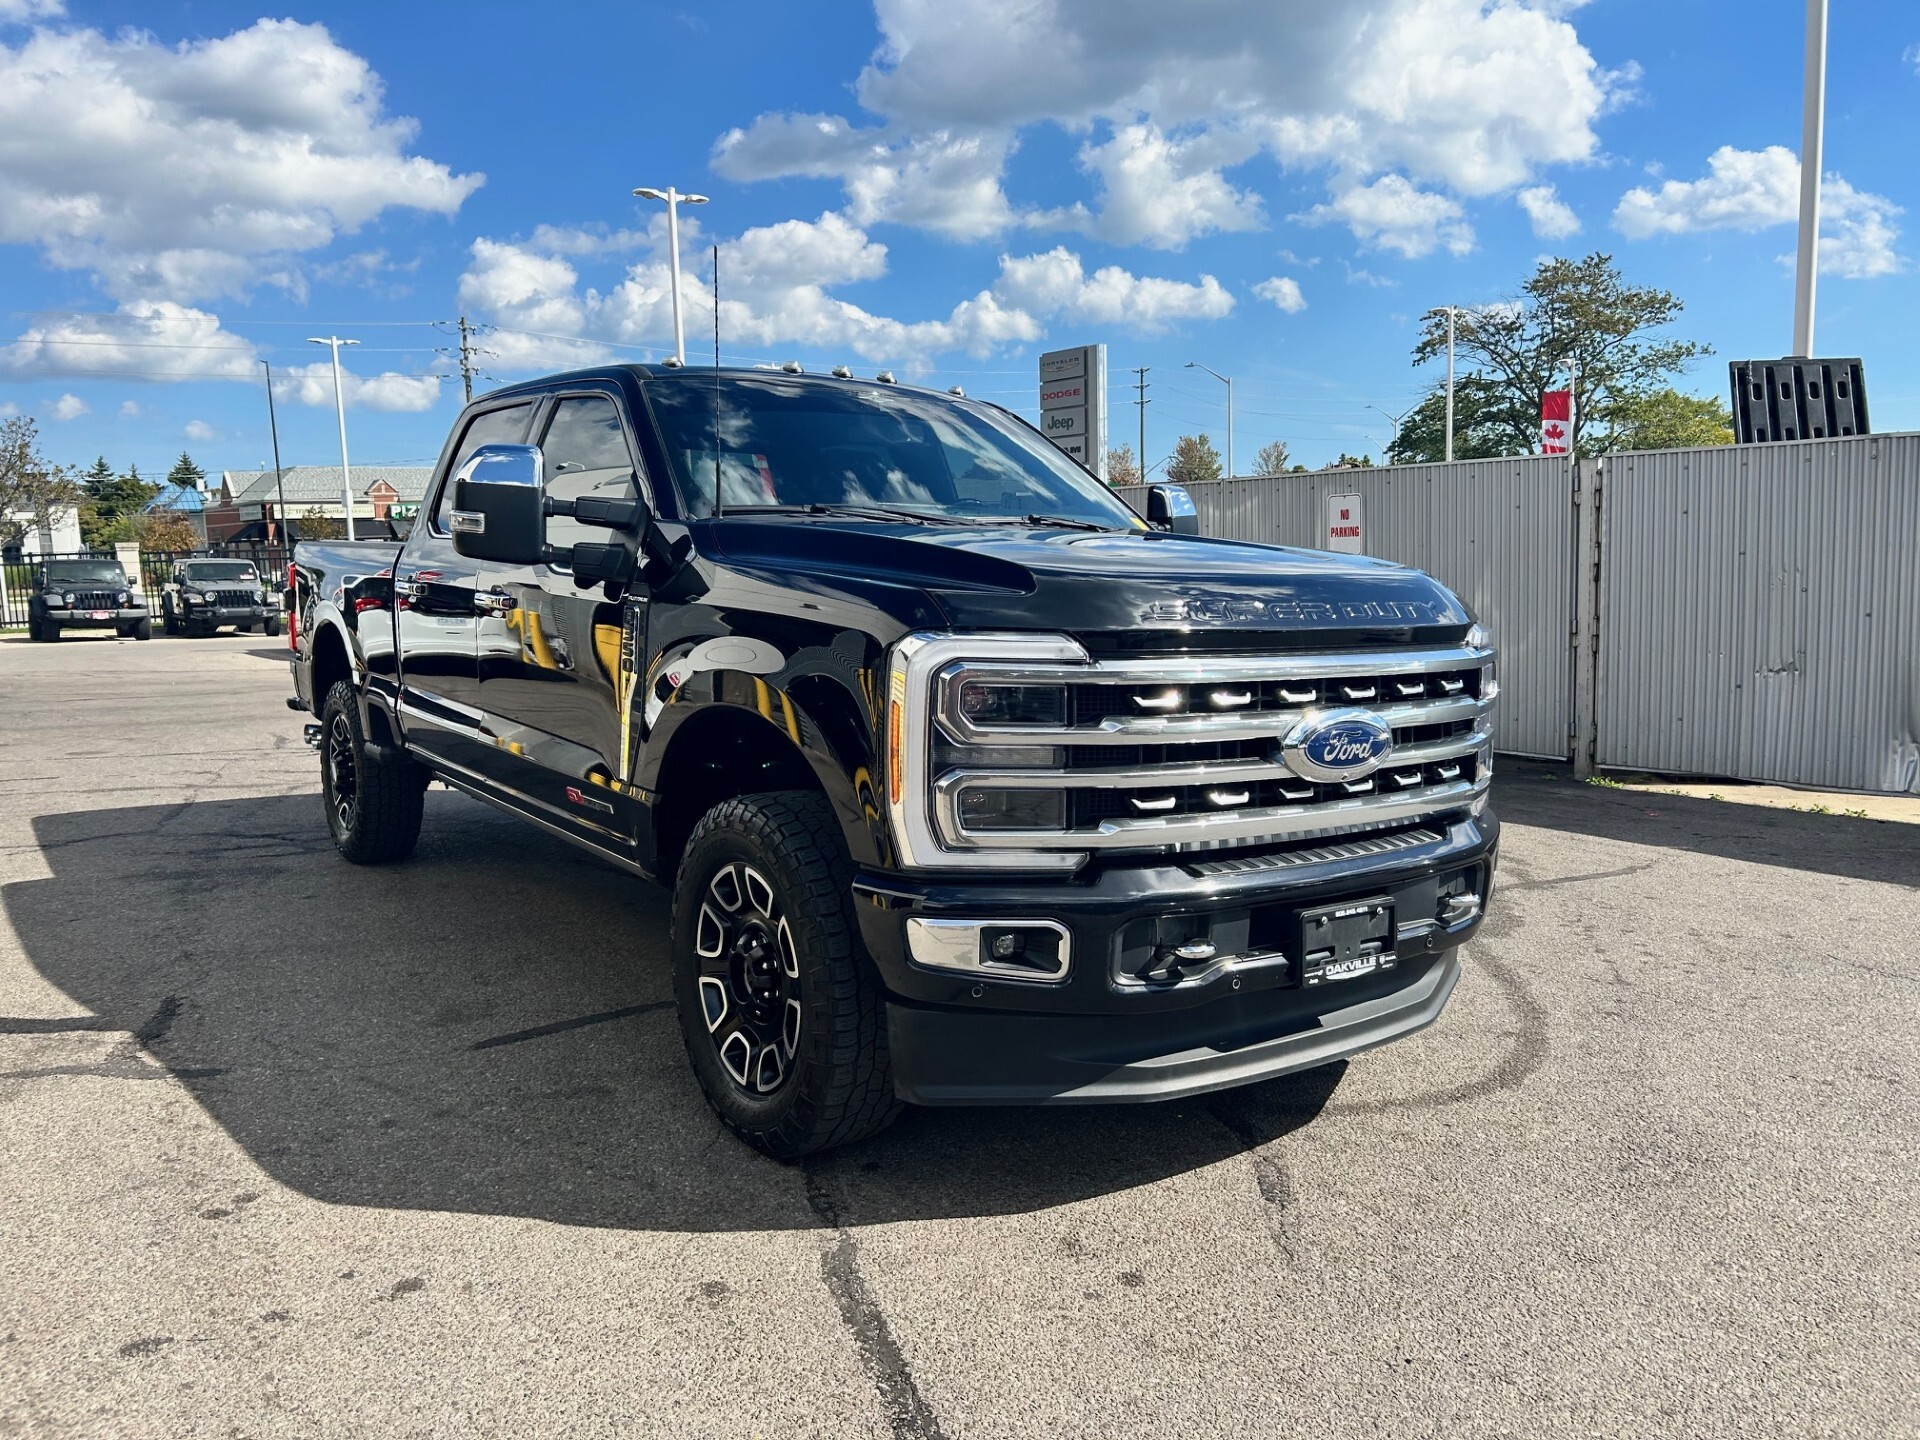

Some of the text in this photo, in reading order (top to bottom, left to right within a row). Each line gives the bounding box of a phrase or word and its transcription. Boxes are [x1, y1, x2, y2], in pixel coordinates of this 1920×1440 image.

[1042, 388, 1080, 400] DODGE
[1048, 416, 1074, 430] Jeep
[391, 505, 421, 517] PIZ
[1340, 508, 1350, 520] NO
[1330, 526, 1360, 538] PARKING
[1338, 600, 1439, 621] DUTY
[1324, 730, 1374, 761] Ford
[1326, 957, 1376, 975] OAKVILLE
